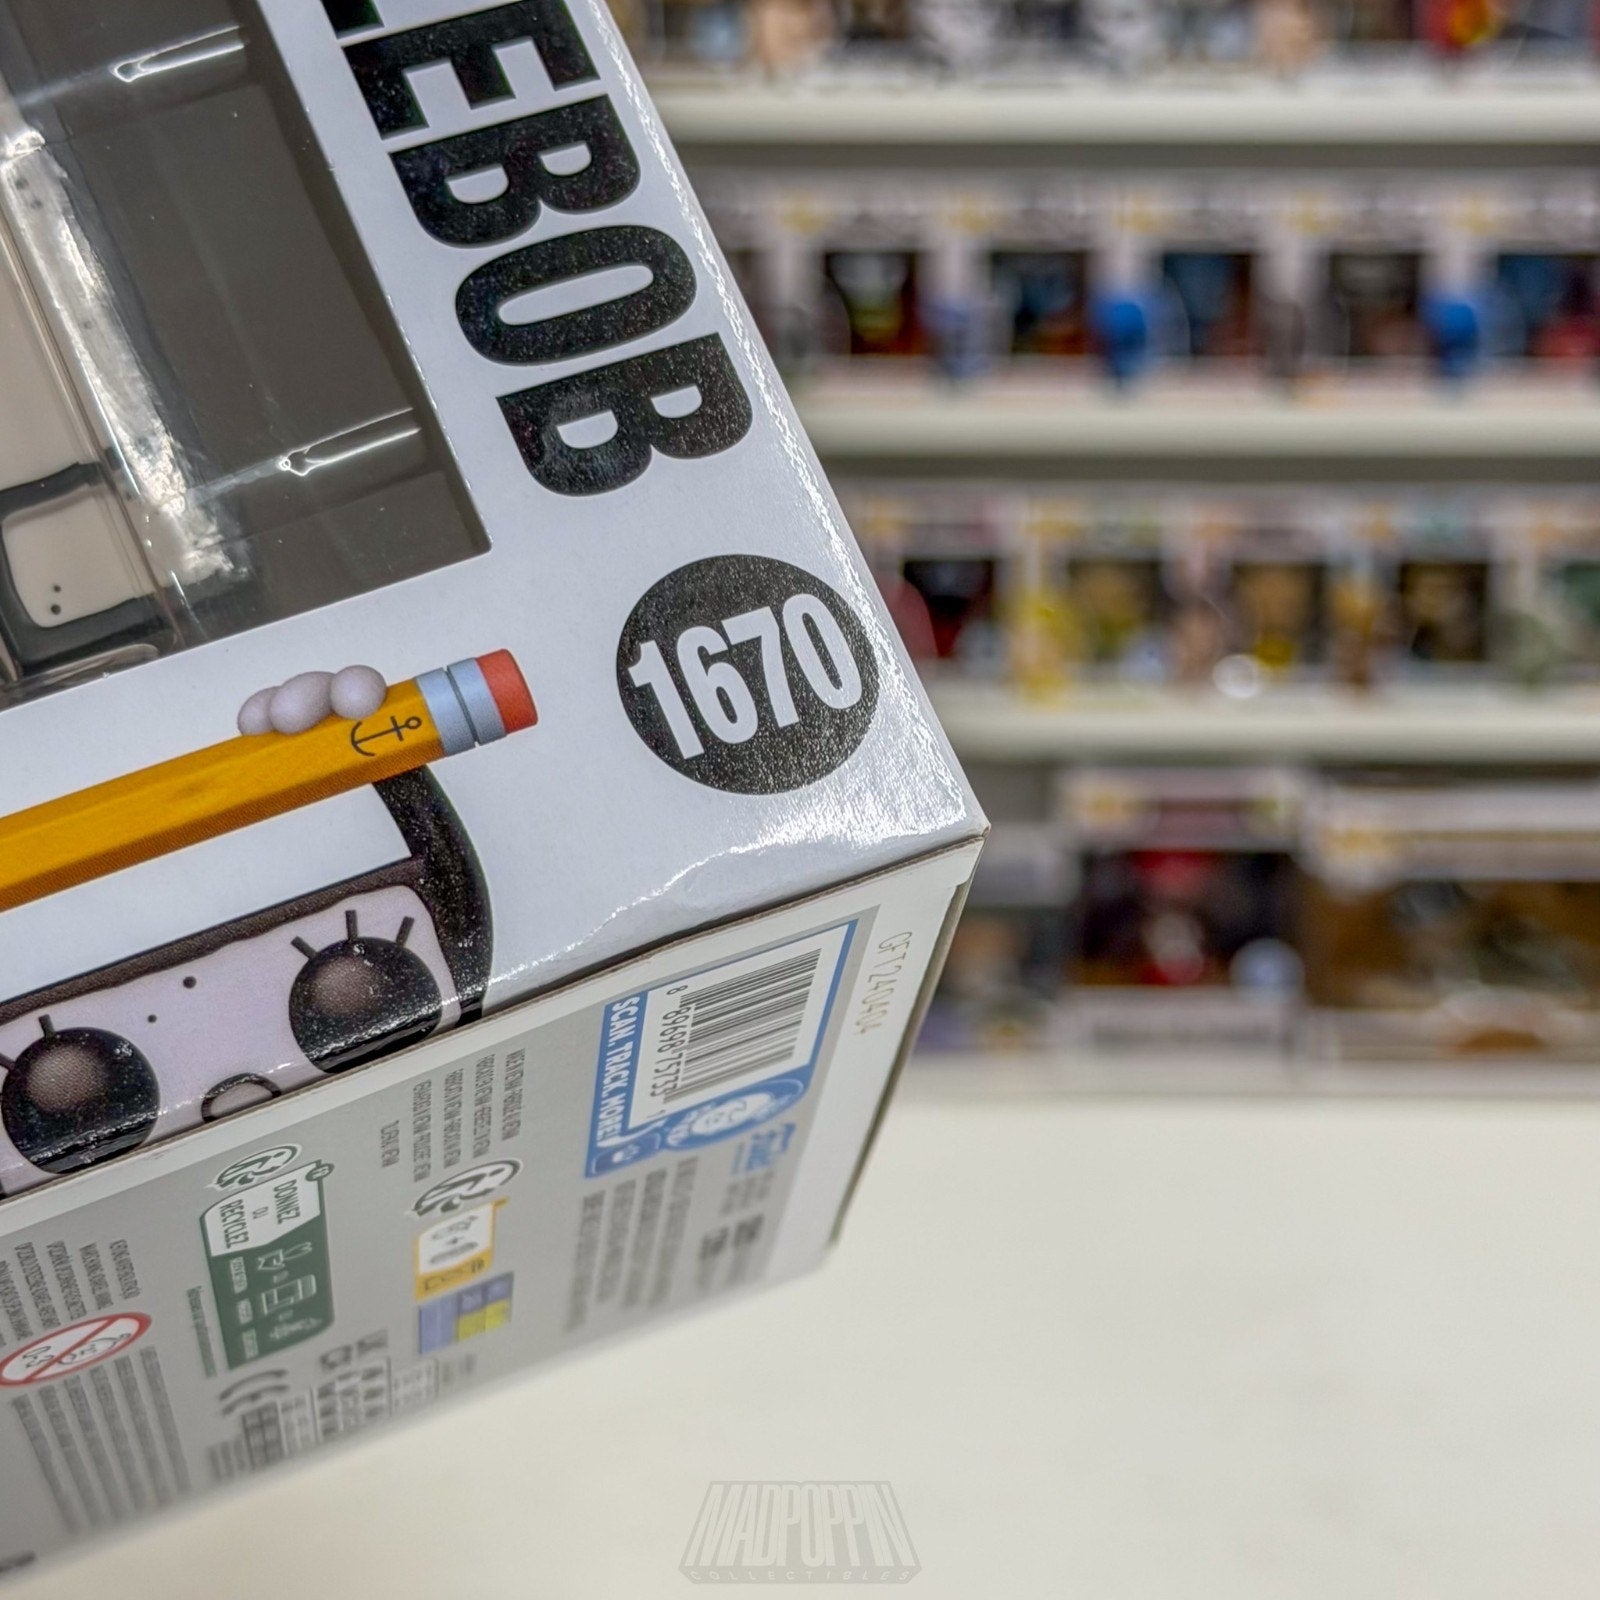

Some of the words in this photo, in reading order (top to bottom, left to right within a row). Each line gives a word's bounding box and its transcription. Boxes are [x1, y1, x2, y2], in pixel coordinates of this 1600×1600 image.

[628, 593, 862, 760] 1670
[666, 985, 689, 996] 8
[608, 996, 640, 1047] SCAN.
[656, 1006, 690, 1053] 89698
[602, 1041, 634, 1098] TRACK.
[220, 1199, 250, 1249] RECYCLEZ
[273, 1179, 300, 1225] DONNEZ
